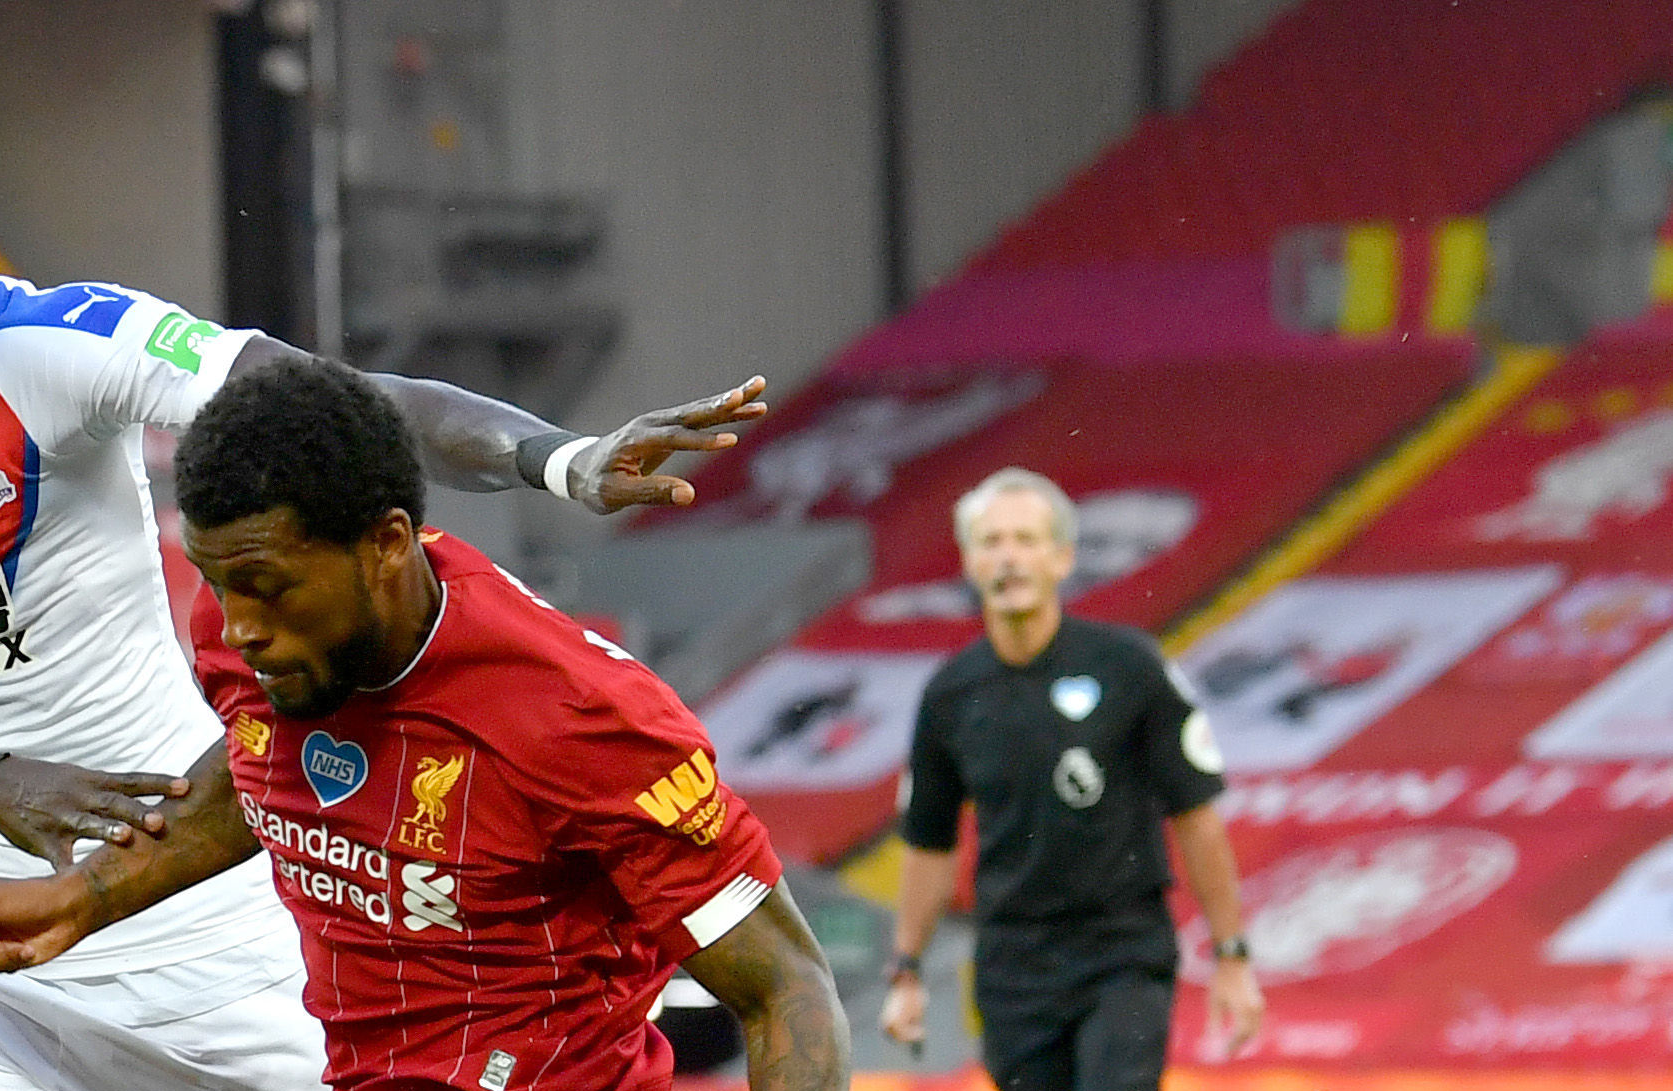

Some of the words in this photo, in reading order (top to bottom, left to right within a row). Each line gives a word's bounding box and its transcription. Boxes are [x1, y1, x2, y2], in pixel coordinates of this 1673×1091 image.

[313, 752, 355, 782] NHS
[633, 747, 715, 828] WU
[239, 791, 390, 881] Standard
[398, 824, 447, 856] L.F.C.
[681, 790, 720, 835] ester
[275, 852, 393, 926] artered
